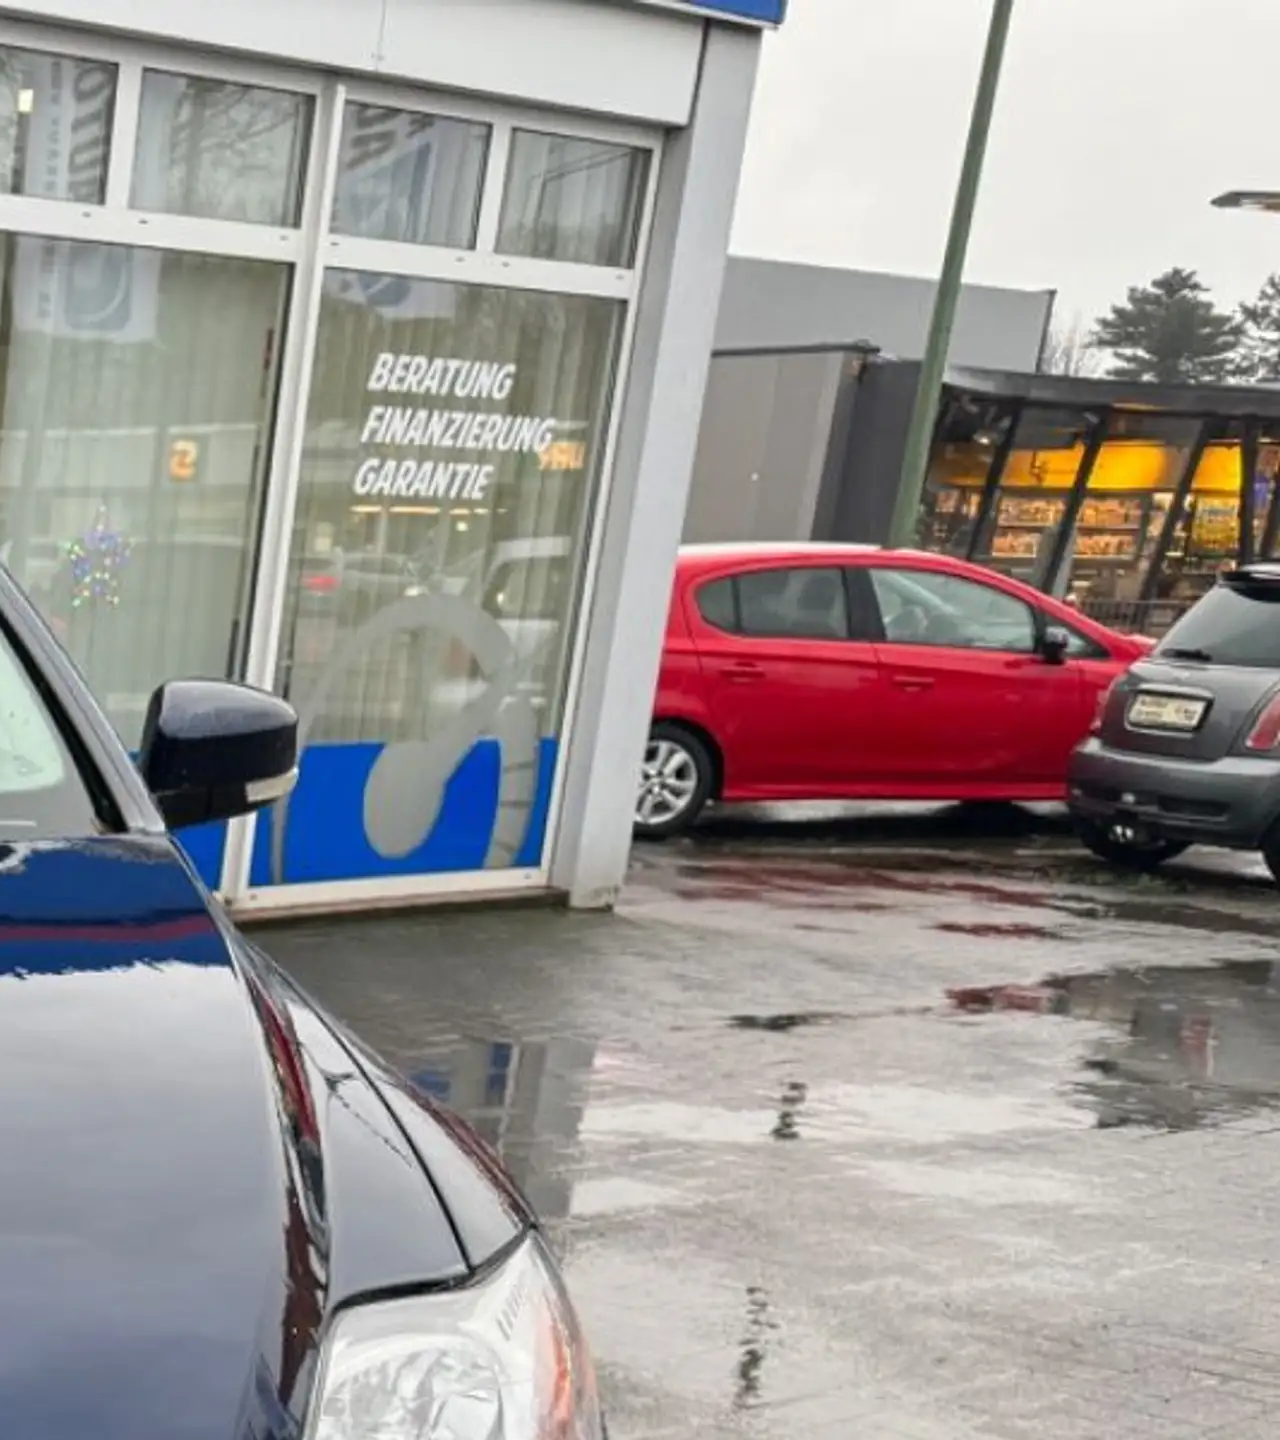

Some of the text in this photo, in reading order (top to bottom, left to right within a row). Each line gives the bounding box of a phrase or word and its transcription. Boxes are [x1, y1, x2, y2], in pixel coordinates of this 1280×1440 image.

[366, 352, 517, 400] BERATUNG
[360, 405, 555, 453] FINANZIERUNG
[352, 457, 495, 500] GARANTIE
